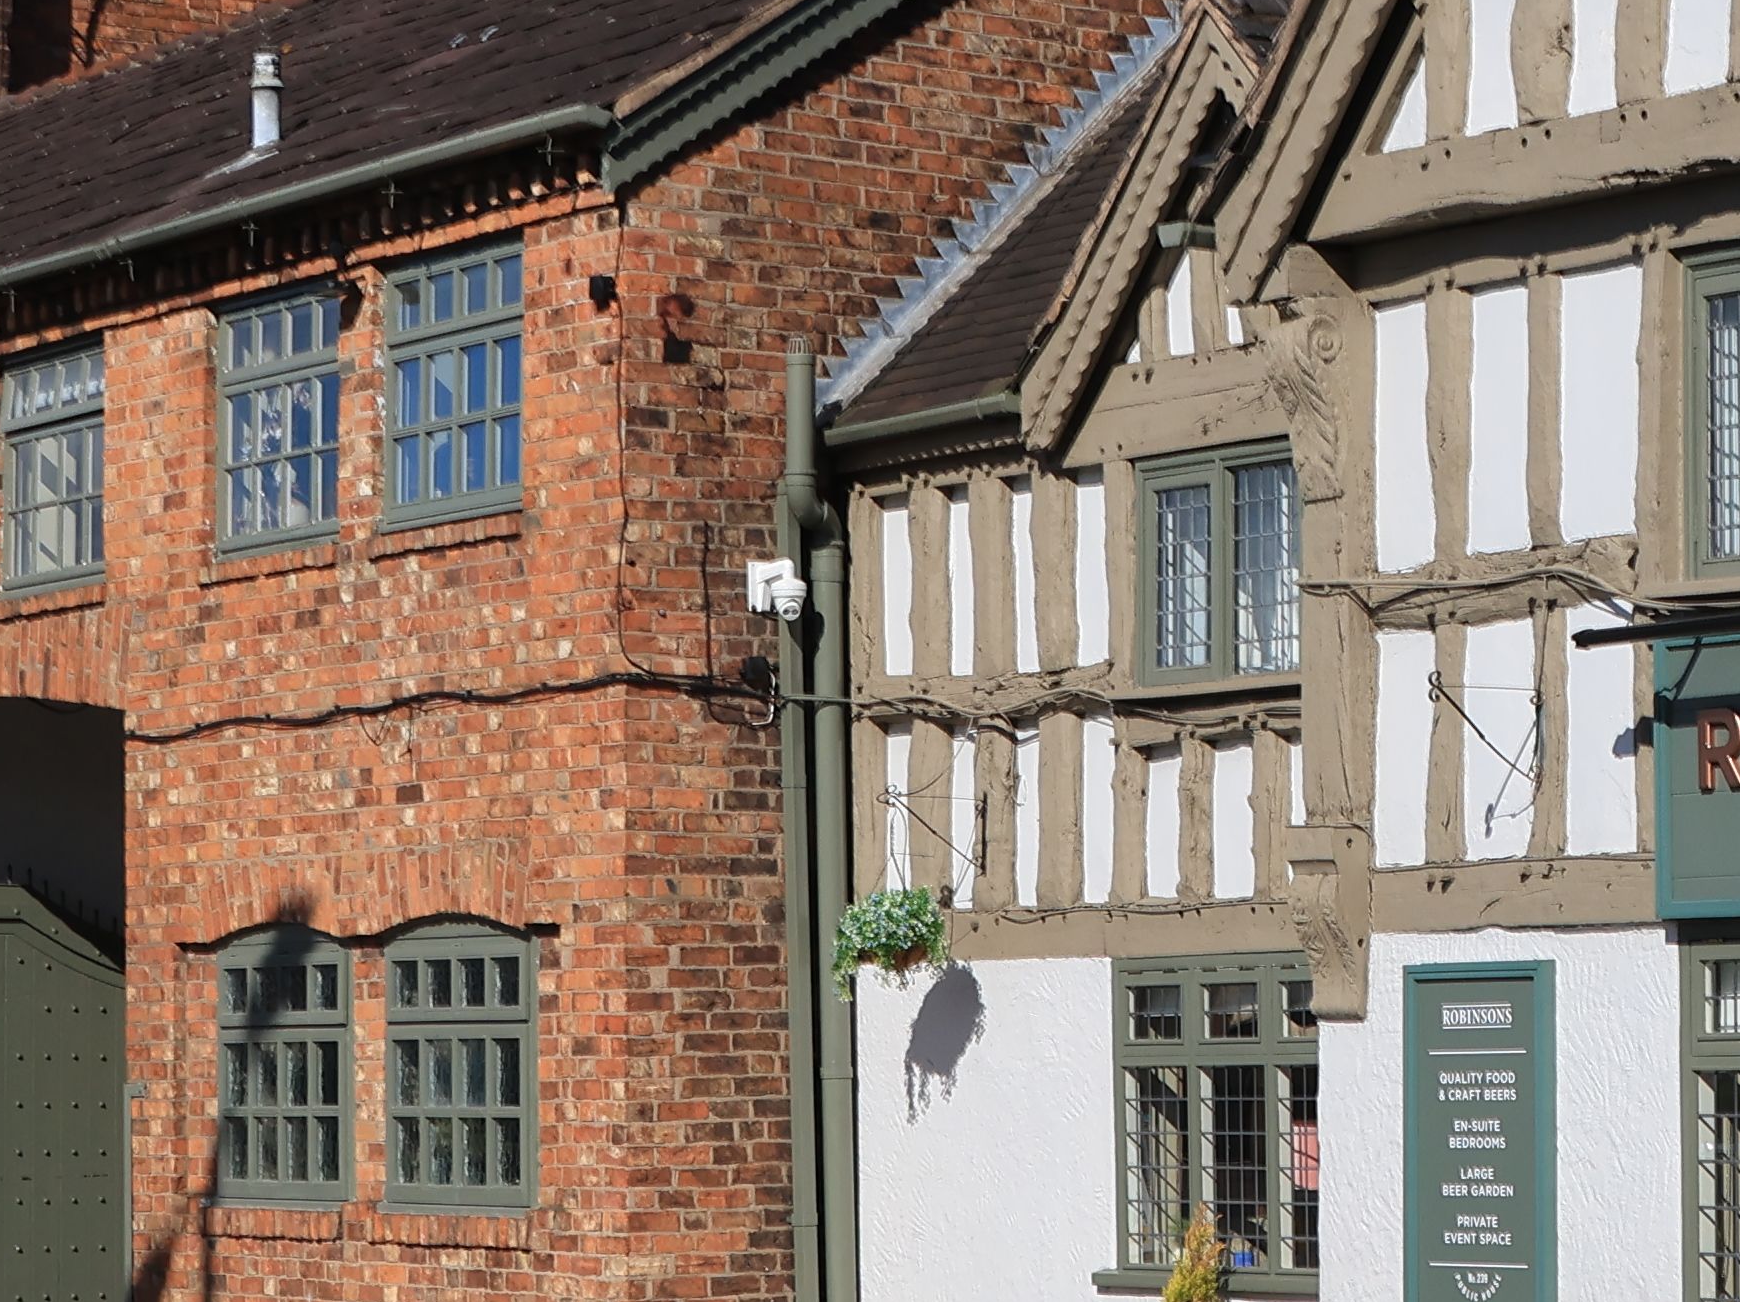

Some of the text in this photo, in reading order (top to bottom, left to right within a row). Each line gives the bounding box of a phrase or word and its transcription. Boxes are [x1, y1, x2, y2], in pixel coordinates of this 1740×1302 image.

[1442, 1008, 1513, 1025] ROBINSONS
[1440, 1072, 1515, 1084] QUALITY FOOD
[1439, 1089, 1517, 1101] & CRAFT BEERS
[1454, 1120, 1501, 1132] EN-SUITE
[1449, 1137, 1506, 1149] BEDROOMS
[1460, 1167, 1494, 1179] LARGE
[1442, 1185, 1514, 1197] BEER GARDEN
[1457, 1216, 1499, 1228] PRIVATE
[1444, 1232, 1512, 1245] EVENT SPACE
[1454, 1273, 1502, 1302] PUBLIC HOUSE
